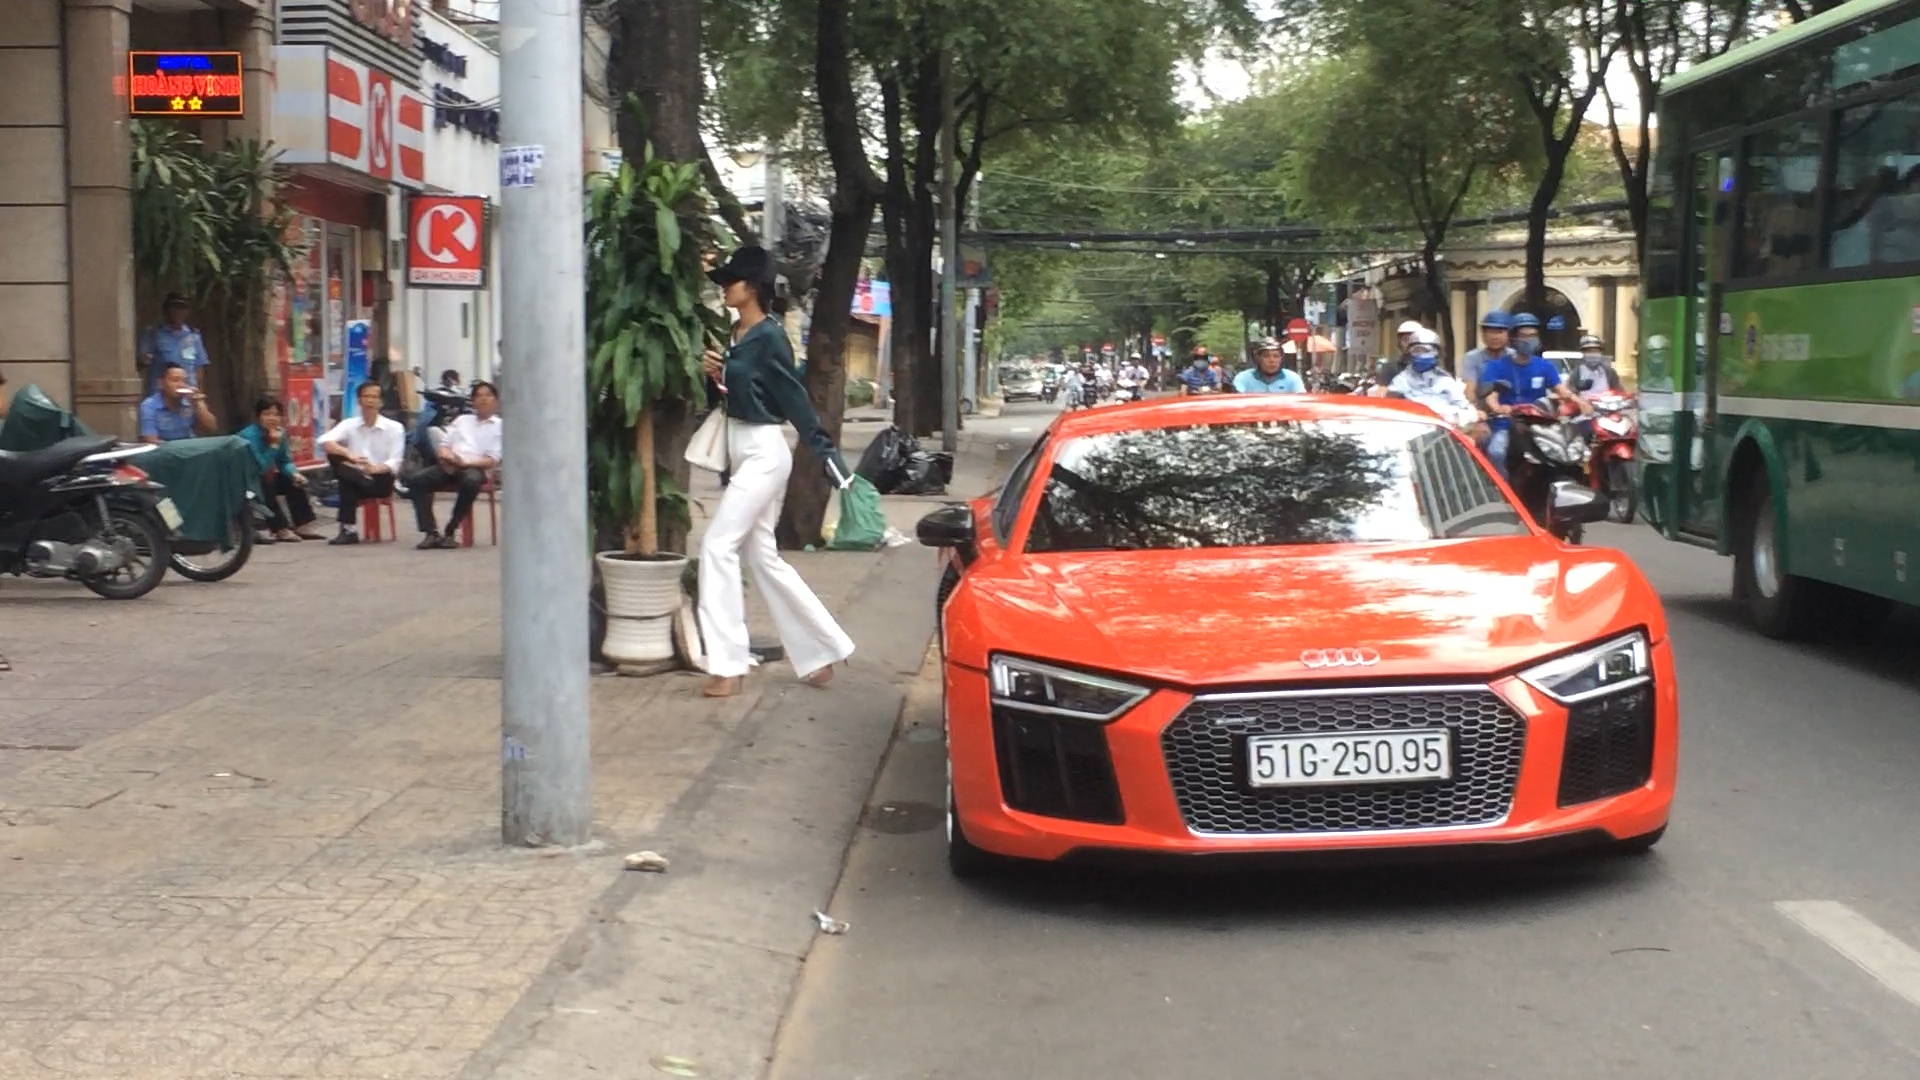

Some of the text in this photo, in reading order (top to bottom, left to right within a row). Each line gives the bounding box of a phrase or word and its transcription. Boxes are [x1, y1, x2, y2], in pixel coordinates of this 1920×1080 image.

[427, 209, 471, 263] K
[432, 270, 477, 282] HOURS
[1256, 737, 1442, 779] 51G-250.95
